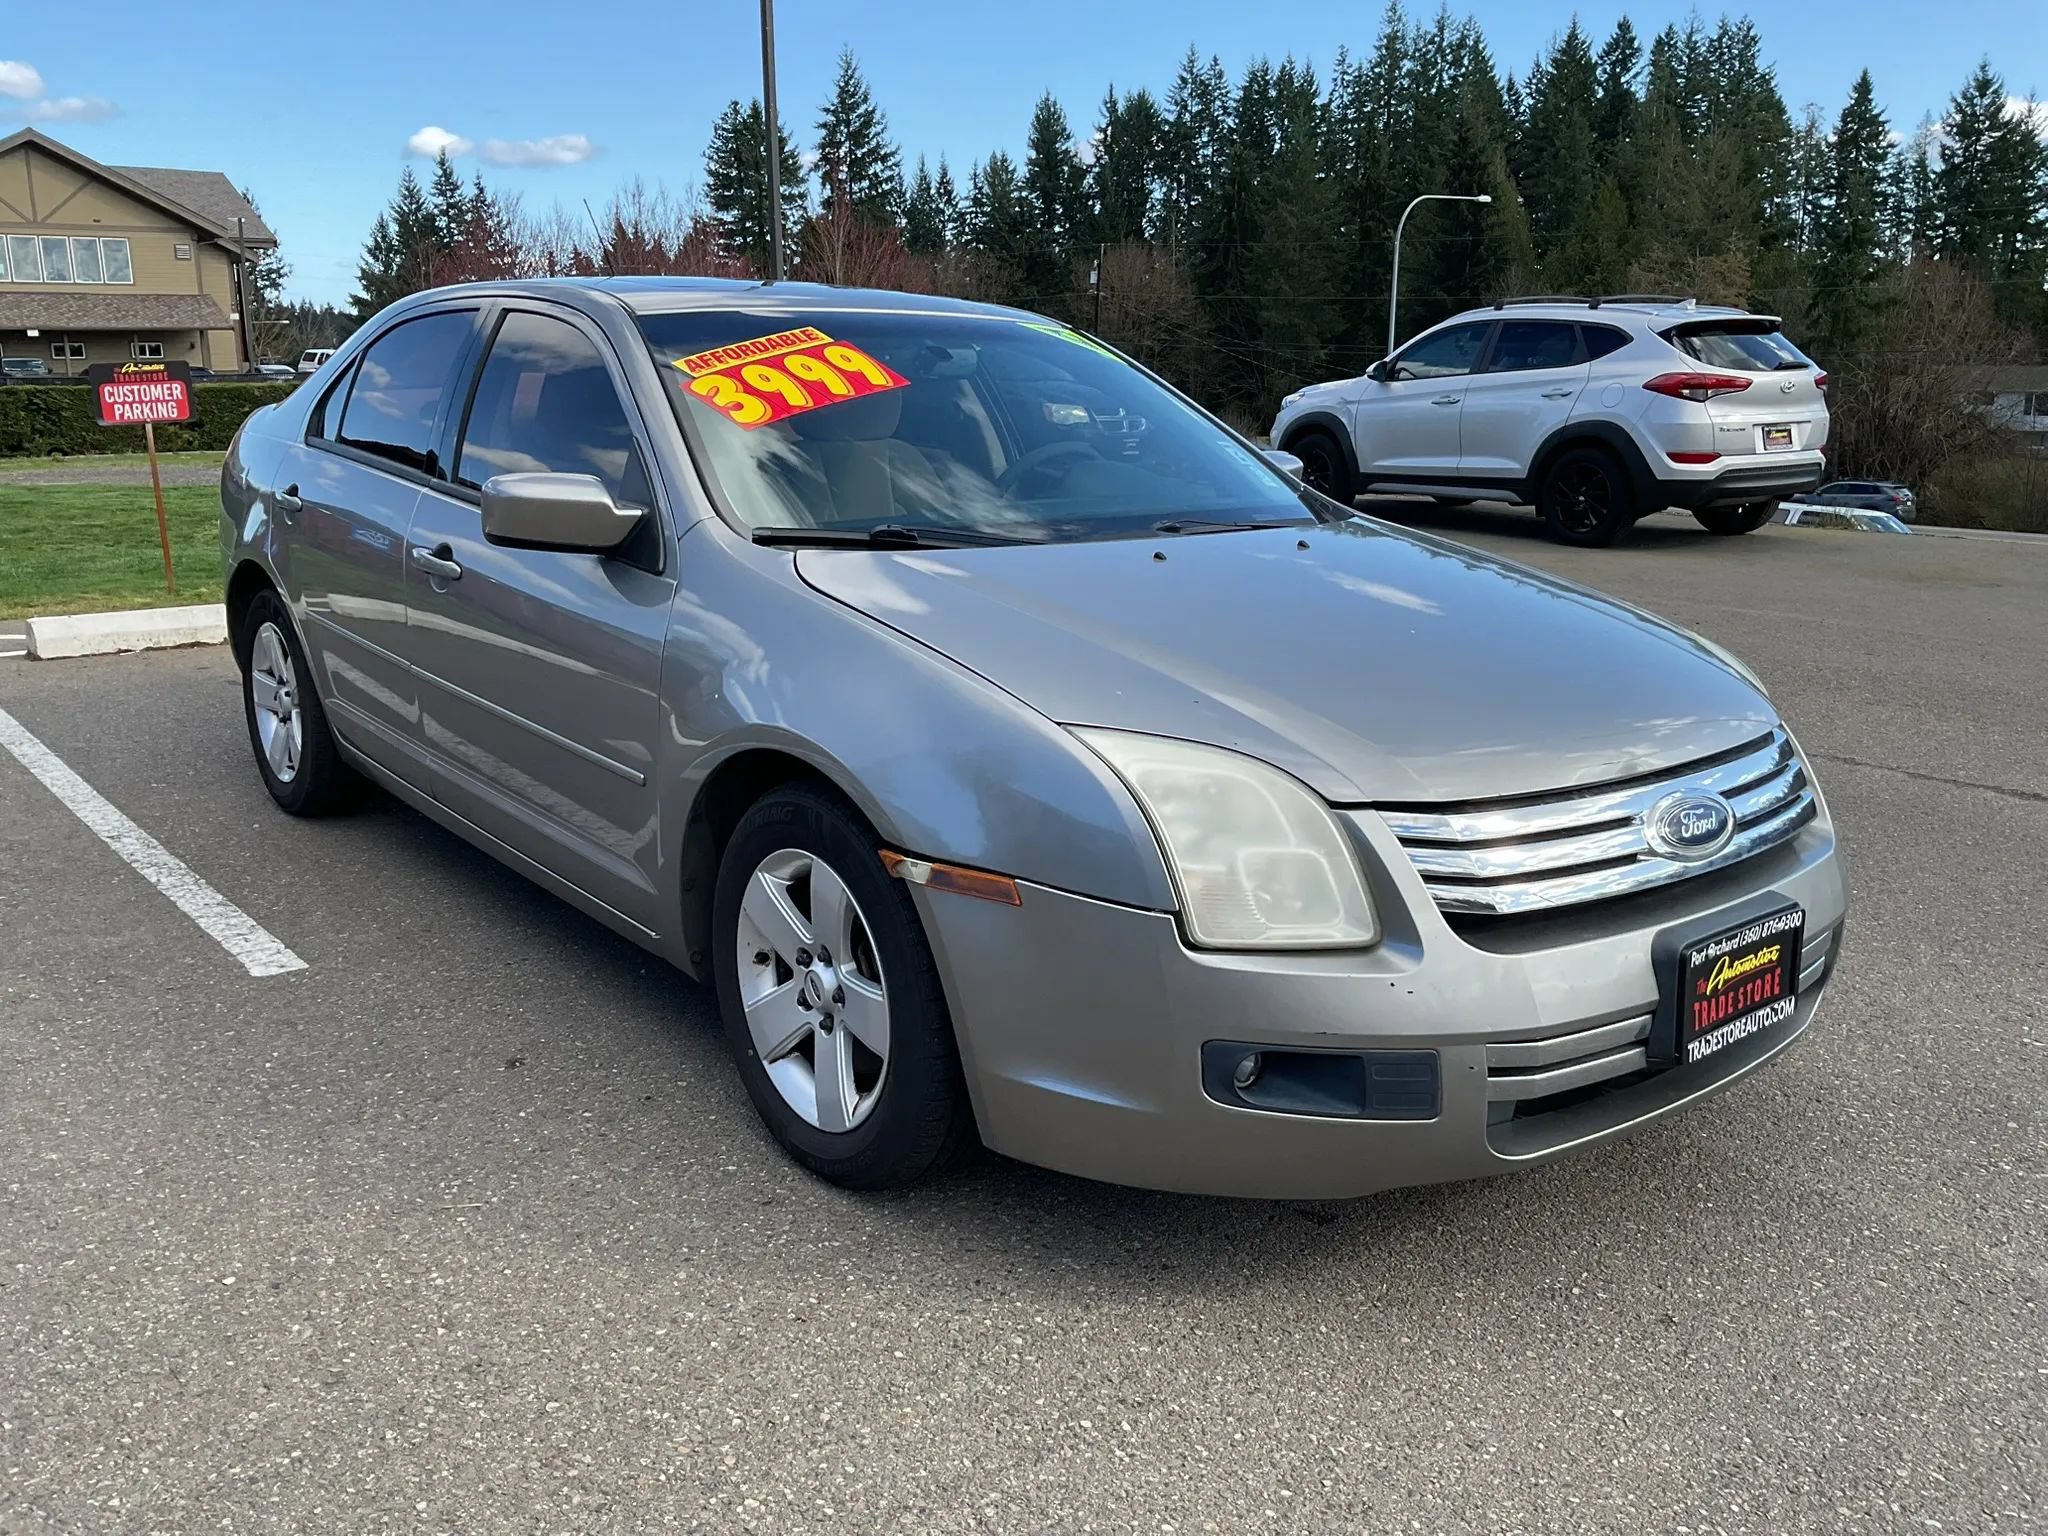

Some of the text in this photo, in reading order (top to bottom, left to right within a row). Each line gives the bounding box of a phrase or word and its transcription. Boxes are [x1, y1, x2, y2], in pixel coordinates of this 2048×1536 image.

[682, 328, 820, 374] AFFORDABLE
[104, 383, 182, 403] CUSTOMER
[689, 345, 894, 425] 3999
[114, 401, 178, 420] PARKING
[1680, 808, 1719, 838] Ford
[1690, 948, 1707, 969] Port
[1739, 923, 1763, 947] (360)
[1706, 944, 1781, 996] Automotive
[1694, 967, 1782, 1031] TRADE STORE
[1687, 995, 1796, 1064] TRADESTOREAUTO.COM
